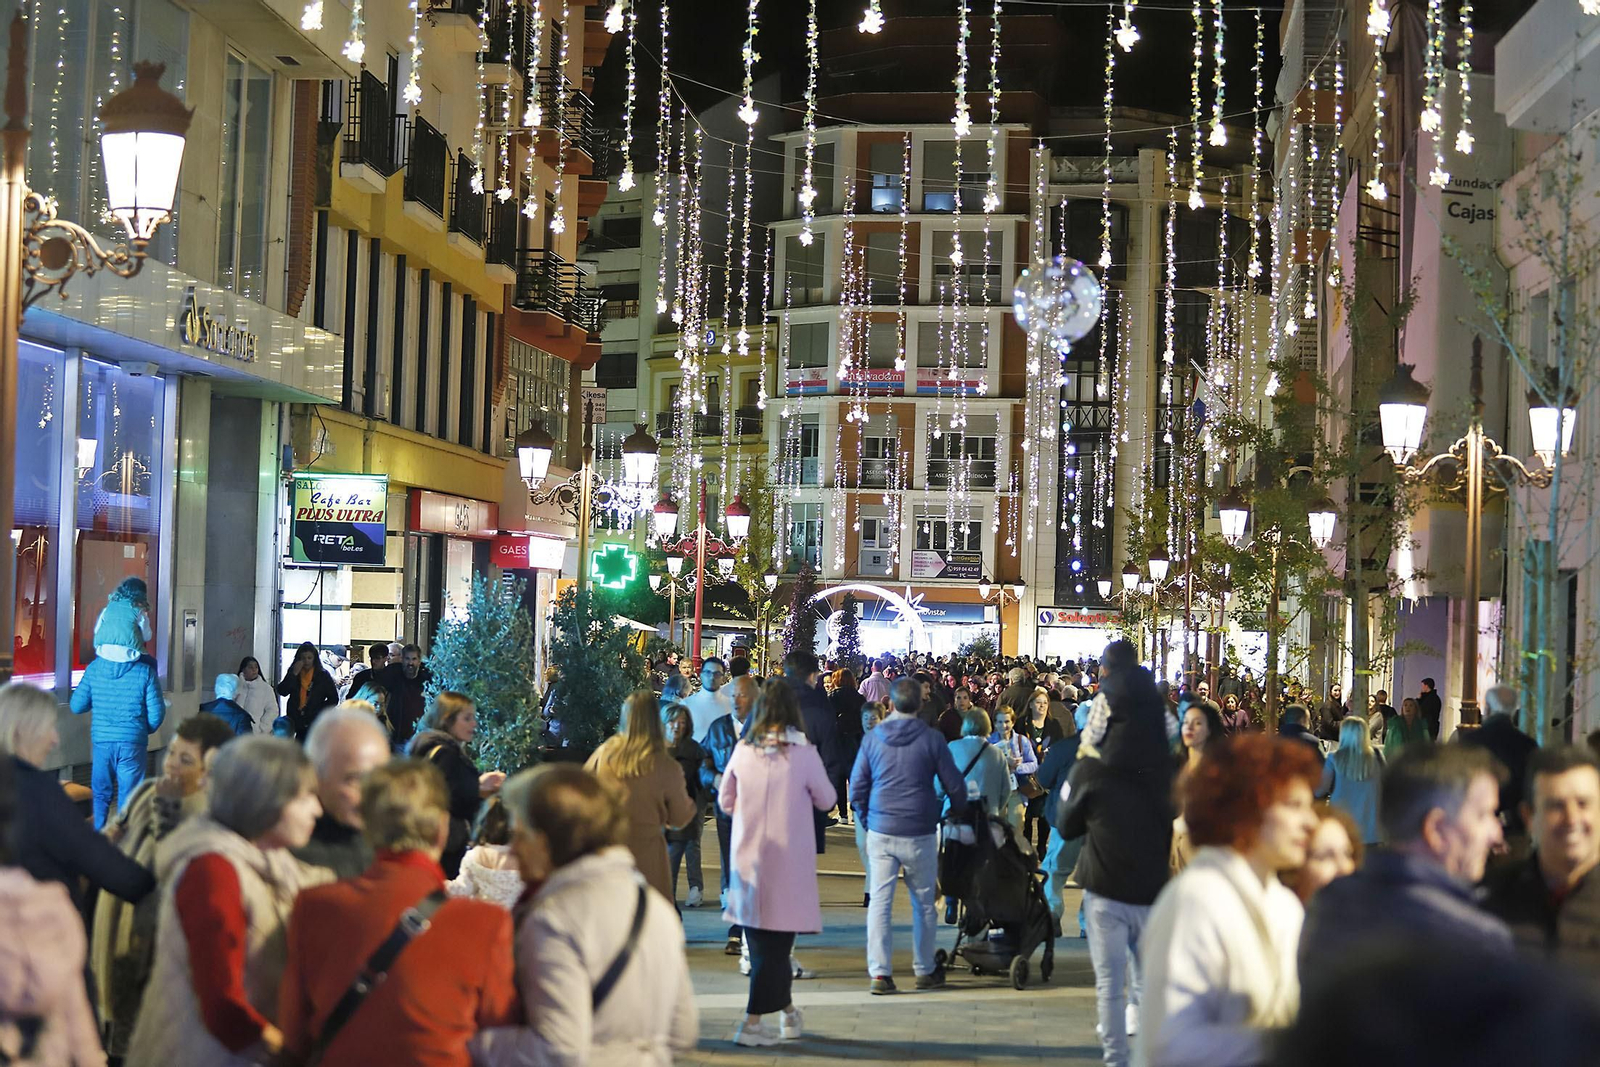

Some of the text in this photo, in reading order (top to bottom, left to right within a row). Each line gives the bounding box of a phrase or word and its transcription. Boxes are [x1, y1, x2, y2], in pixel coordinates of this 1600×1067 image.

[1447, 202, 1497, 224] Cajas
[346, 493, 371, 506] Bar
[296, 507, 384, 523] PLUS ULTRA
[499, 545, 527, 555] GAES
